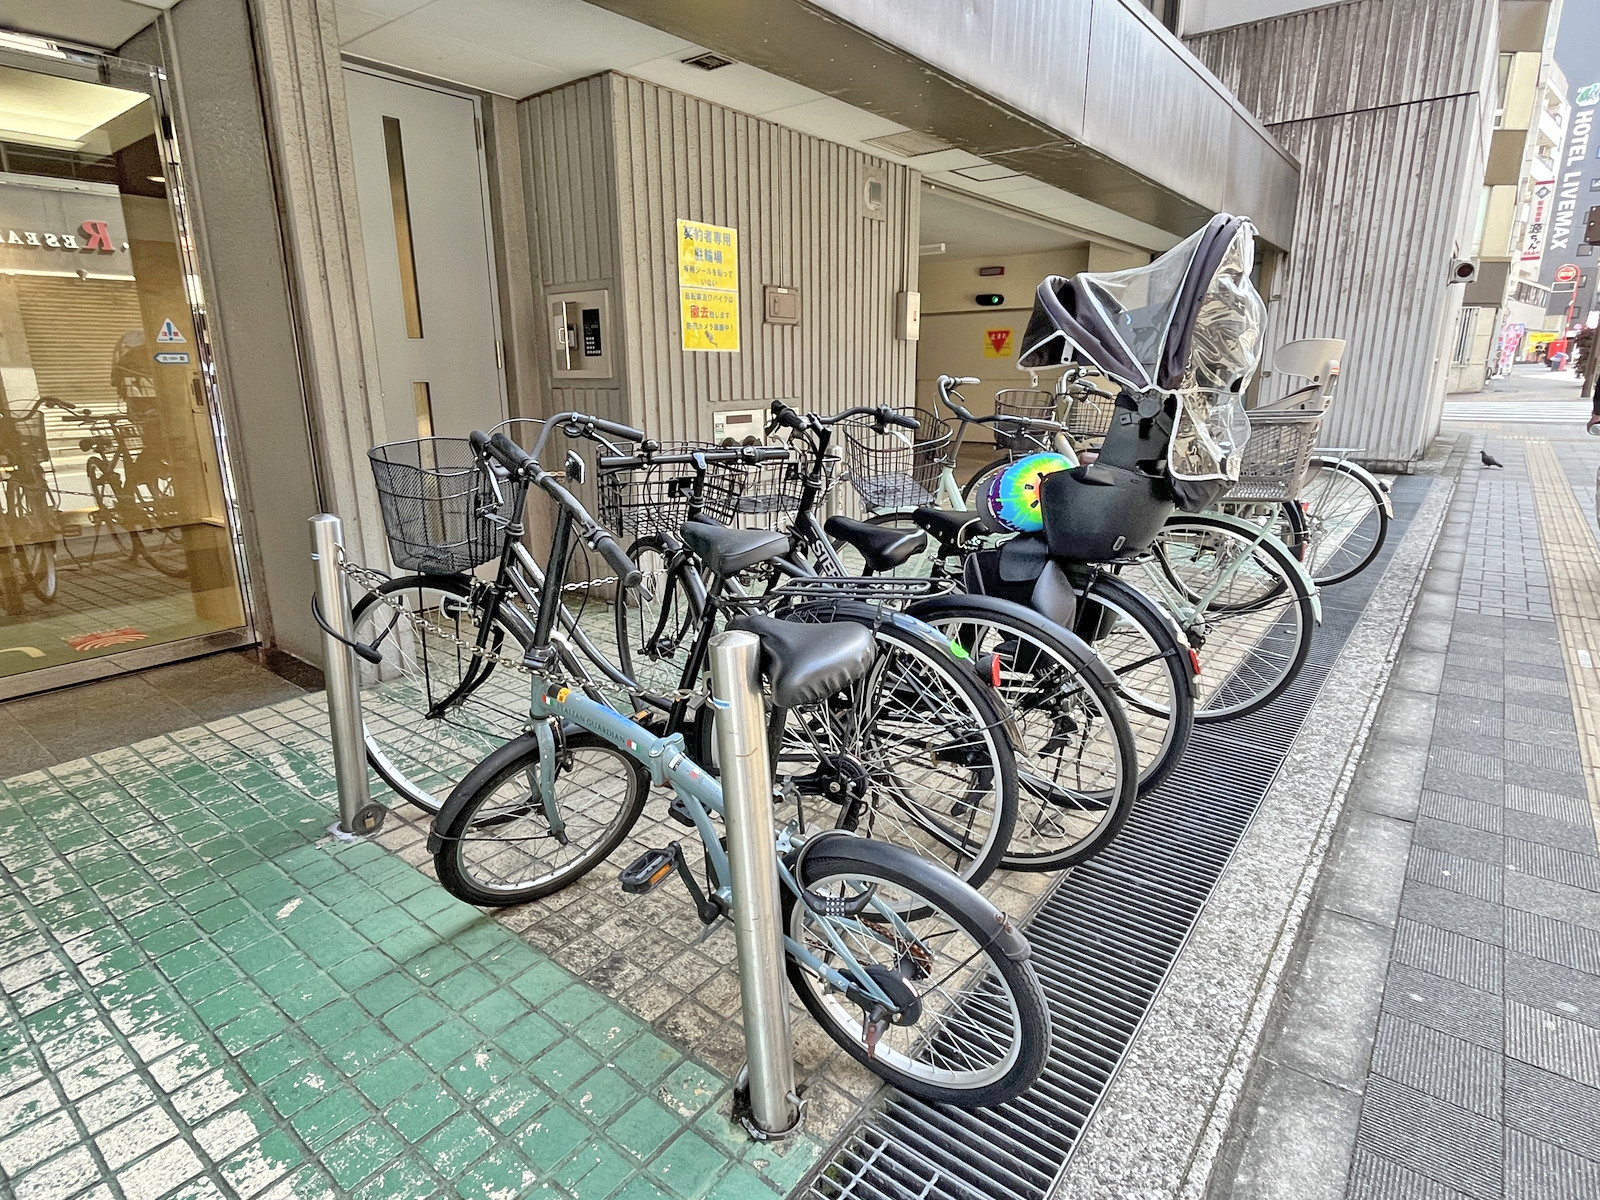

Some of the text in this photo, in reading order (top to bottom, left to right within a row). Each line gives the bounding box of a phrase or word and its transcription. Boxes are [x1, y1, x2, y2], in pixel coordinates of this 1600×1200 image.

[1566, 109, 1594, 167] HOTEL
[1548, 170, 1582, 251] LIVEMAX
[684, 226, 731, 246] 契約者専用
[695, 248, 722, 264] 駐輪場
[557, 702, 626, 744] ITALIAN GUARDIAN
